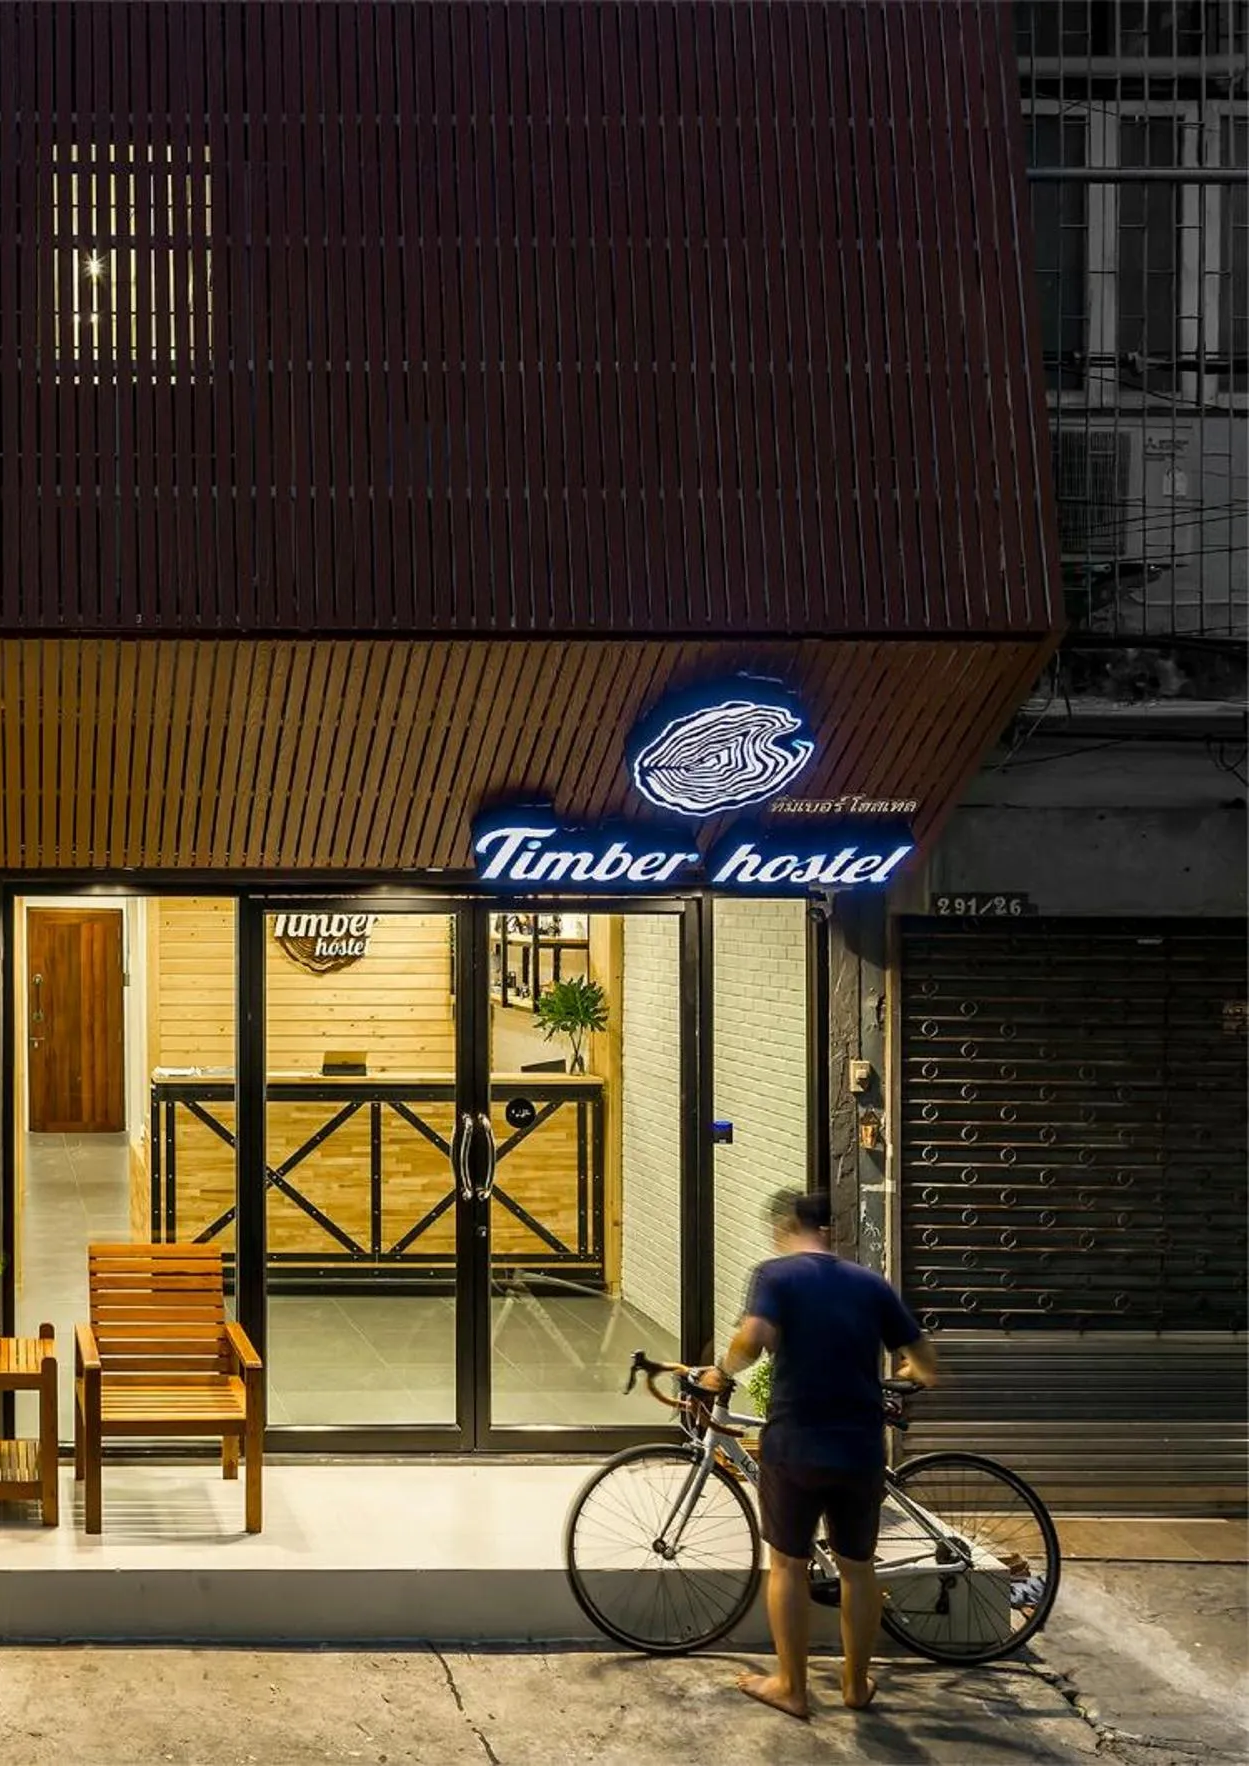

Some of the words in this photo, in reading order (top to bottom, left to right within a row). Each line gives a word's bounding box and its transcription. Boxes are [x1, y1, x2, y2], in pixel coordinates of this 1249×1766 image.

[475, 827, 699, 882] Timber
[712, 842, 913, 884] hostel
[937, 896, 1022, 916] 291/26
[314, 937, 371, 956] hostel
